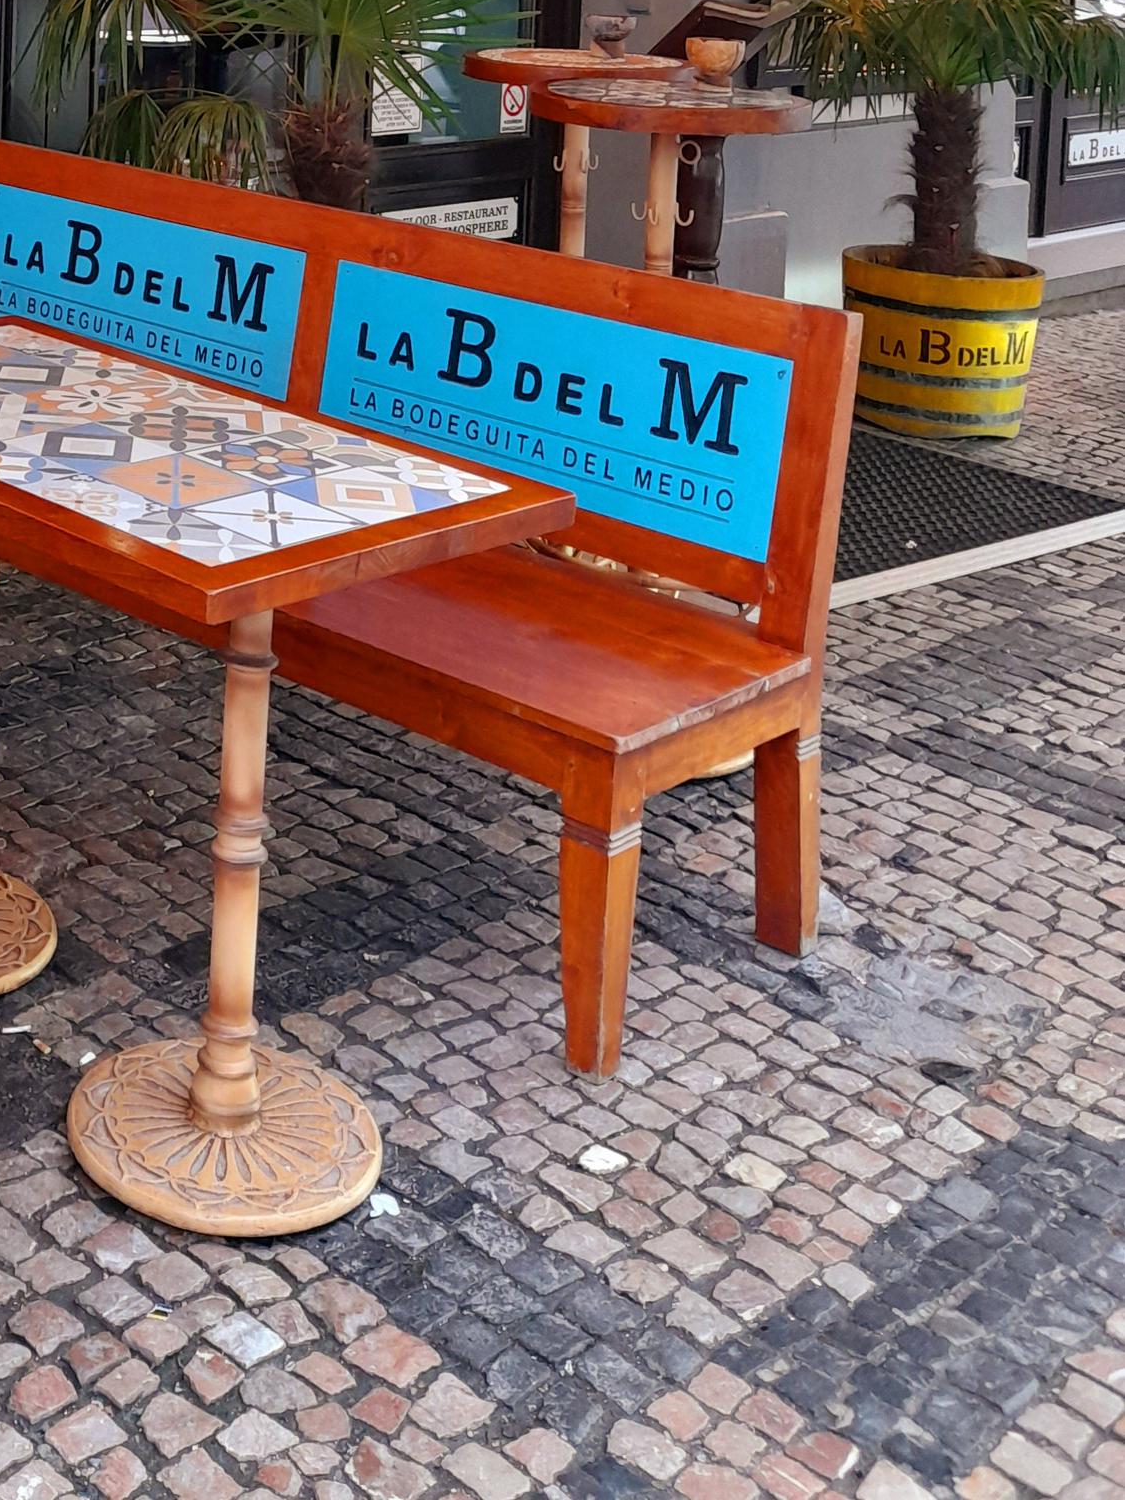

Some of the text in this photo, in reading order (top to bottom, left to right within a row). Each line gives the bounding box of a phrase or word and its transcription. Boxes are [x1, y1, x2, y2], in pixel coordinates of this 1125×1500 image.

[1072, 138, 1120, 162] LA B DEL
[444, 205, 509, 223] RESTAURANT
[3, 219, 275, 332] LA B DEL M
[27, 296, 135, 344] BODEGUITA
[146, 330, 183, 359] DEL
[194, 344, 264, 379] MEDIO
[878, 328, 1030, 367] LA B DEL M
[356, 307, 749, 456] LA B DEL M
[349, 387, 735, 512] LA BODEGUITA DEL MEDIO
